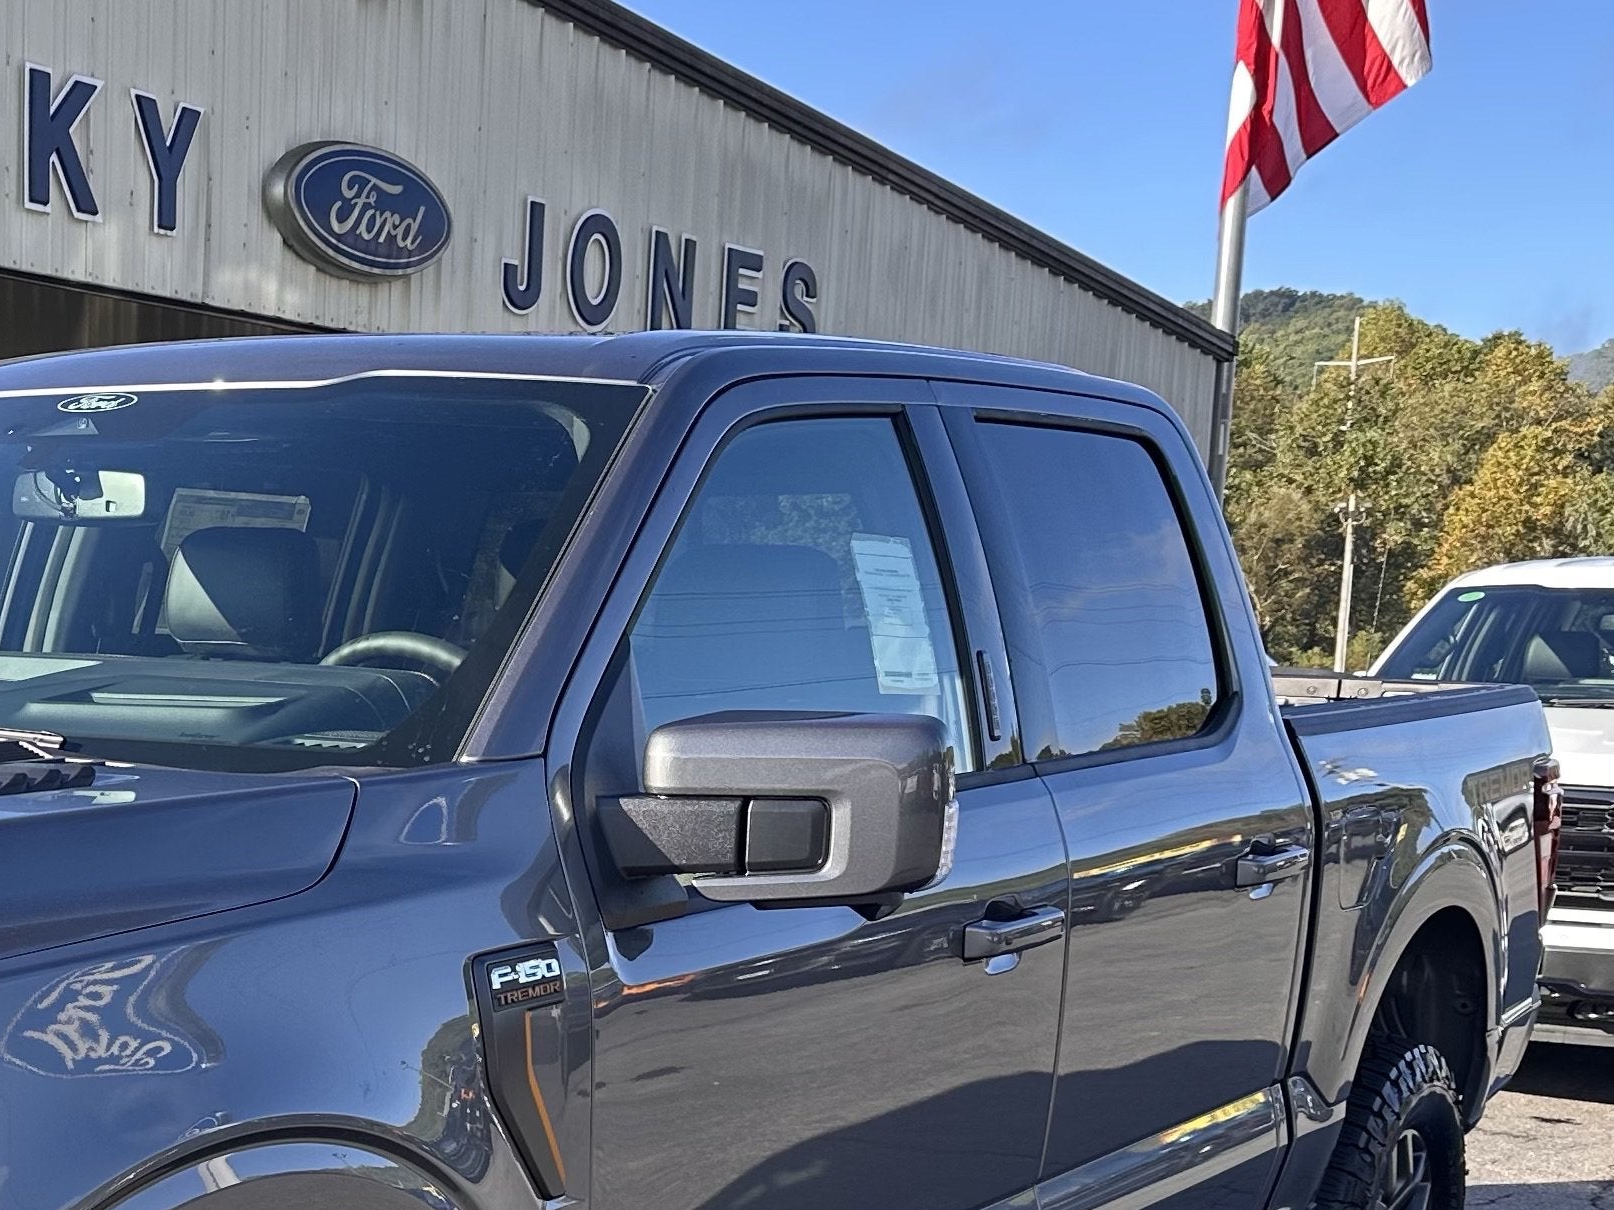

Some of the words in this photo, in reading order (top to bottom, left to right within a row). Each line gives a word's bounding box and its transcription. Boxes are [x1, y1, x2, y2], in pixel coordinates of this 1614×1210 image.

[329, 170, 426, 250] Ford
[499, 195, 818, 333] JONES
[67, 395, 126, 410] Ford
[490, 958, 561, 990] F-150
[497, 981, 561, 1005] TREMOR
